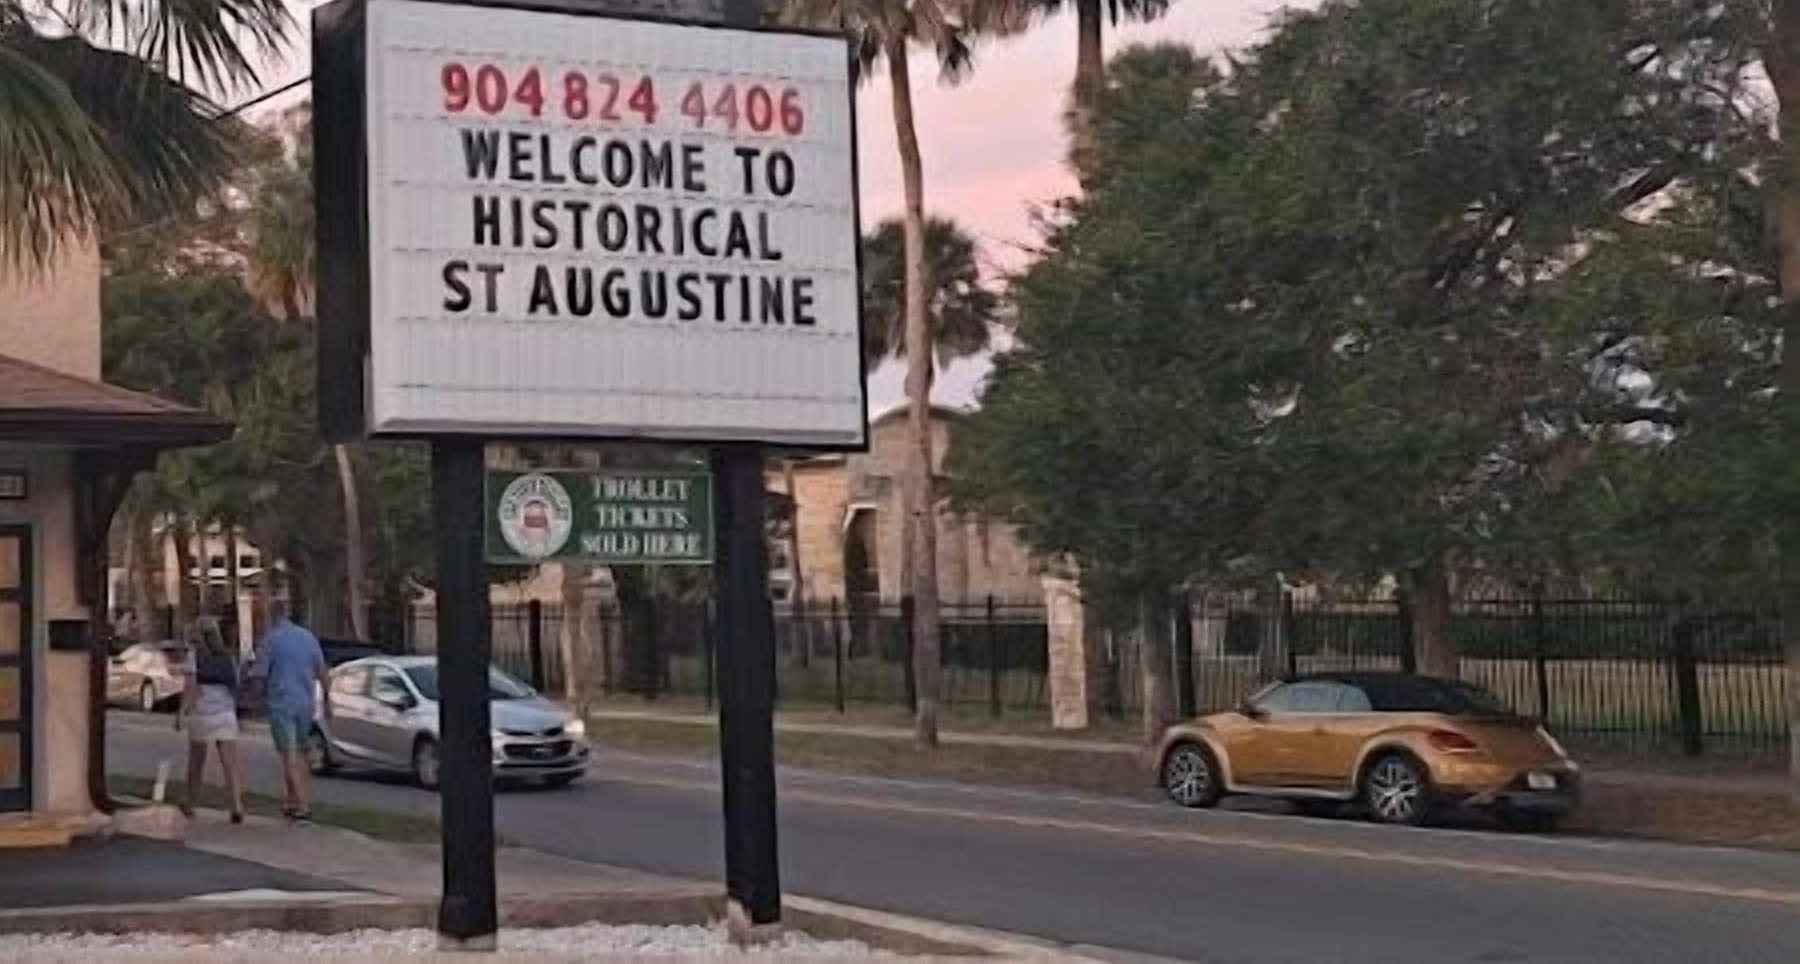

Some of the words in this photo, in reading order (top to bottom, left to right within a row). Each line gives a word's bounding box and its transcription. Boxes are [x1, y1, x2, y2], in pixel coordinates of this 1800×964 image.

[441, 62, 544, 116] 904
[563, 72, 658, 123] 824
[681, 82, 804, 135] 4406
[461, 129, 706, 192] WELCOME
[735, 147, 795, 197] TO
[472, 195, 783, 261] HISTORICAL
[441, 261, 504, 312] ST
[527, 265, 817, 326] AUGUSTINE
